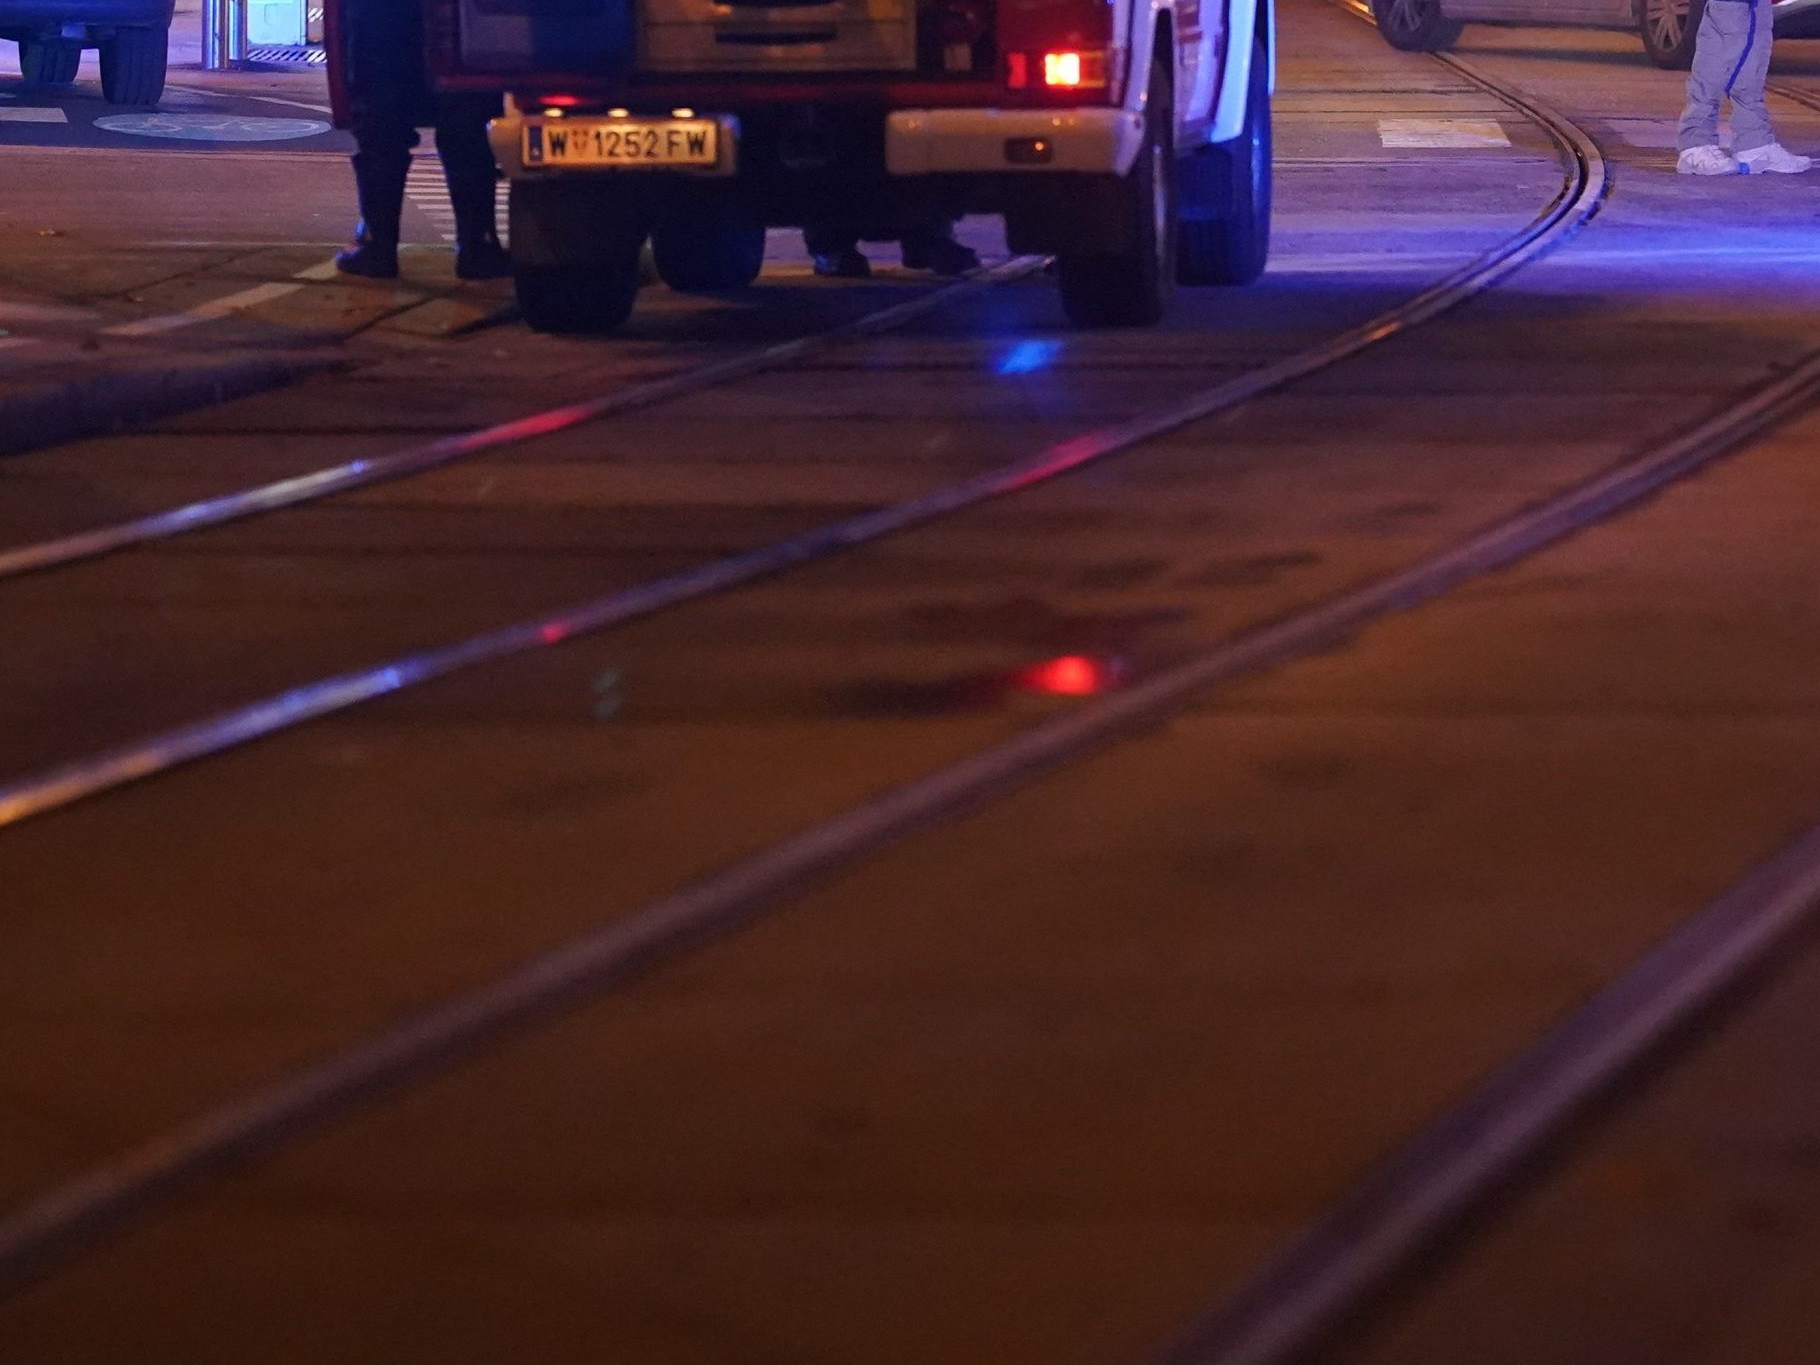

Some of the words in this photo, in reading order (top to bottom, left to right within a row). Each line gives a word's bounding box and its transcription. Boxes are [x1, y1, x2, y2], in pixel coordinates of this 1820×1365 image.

[549, 130, 568, 157] W
[593, 130, 658, 158] 1252
[666, 130, 708, 158] FW
